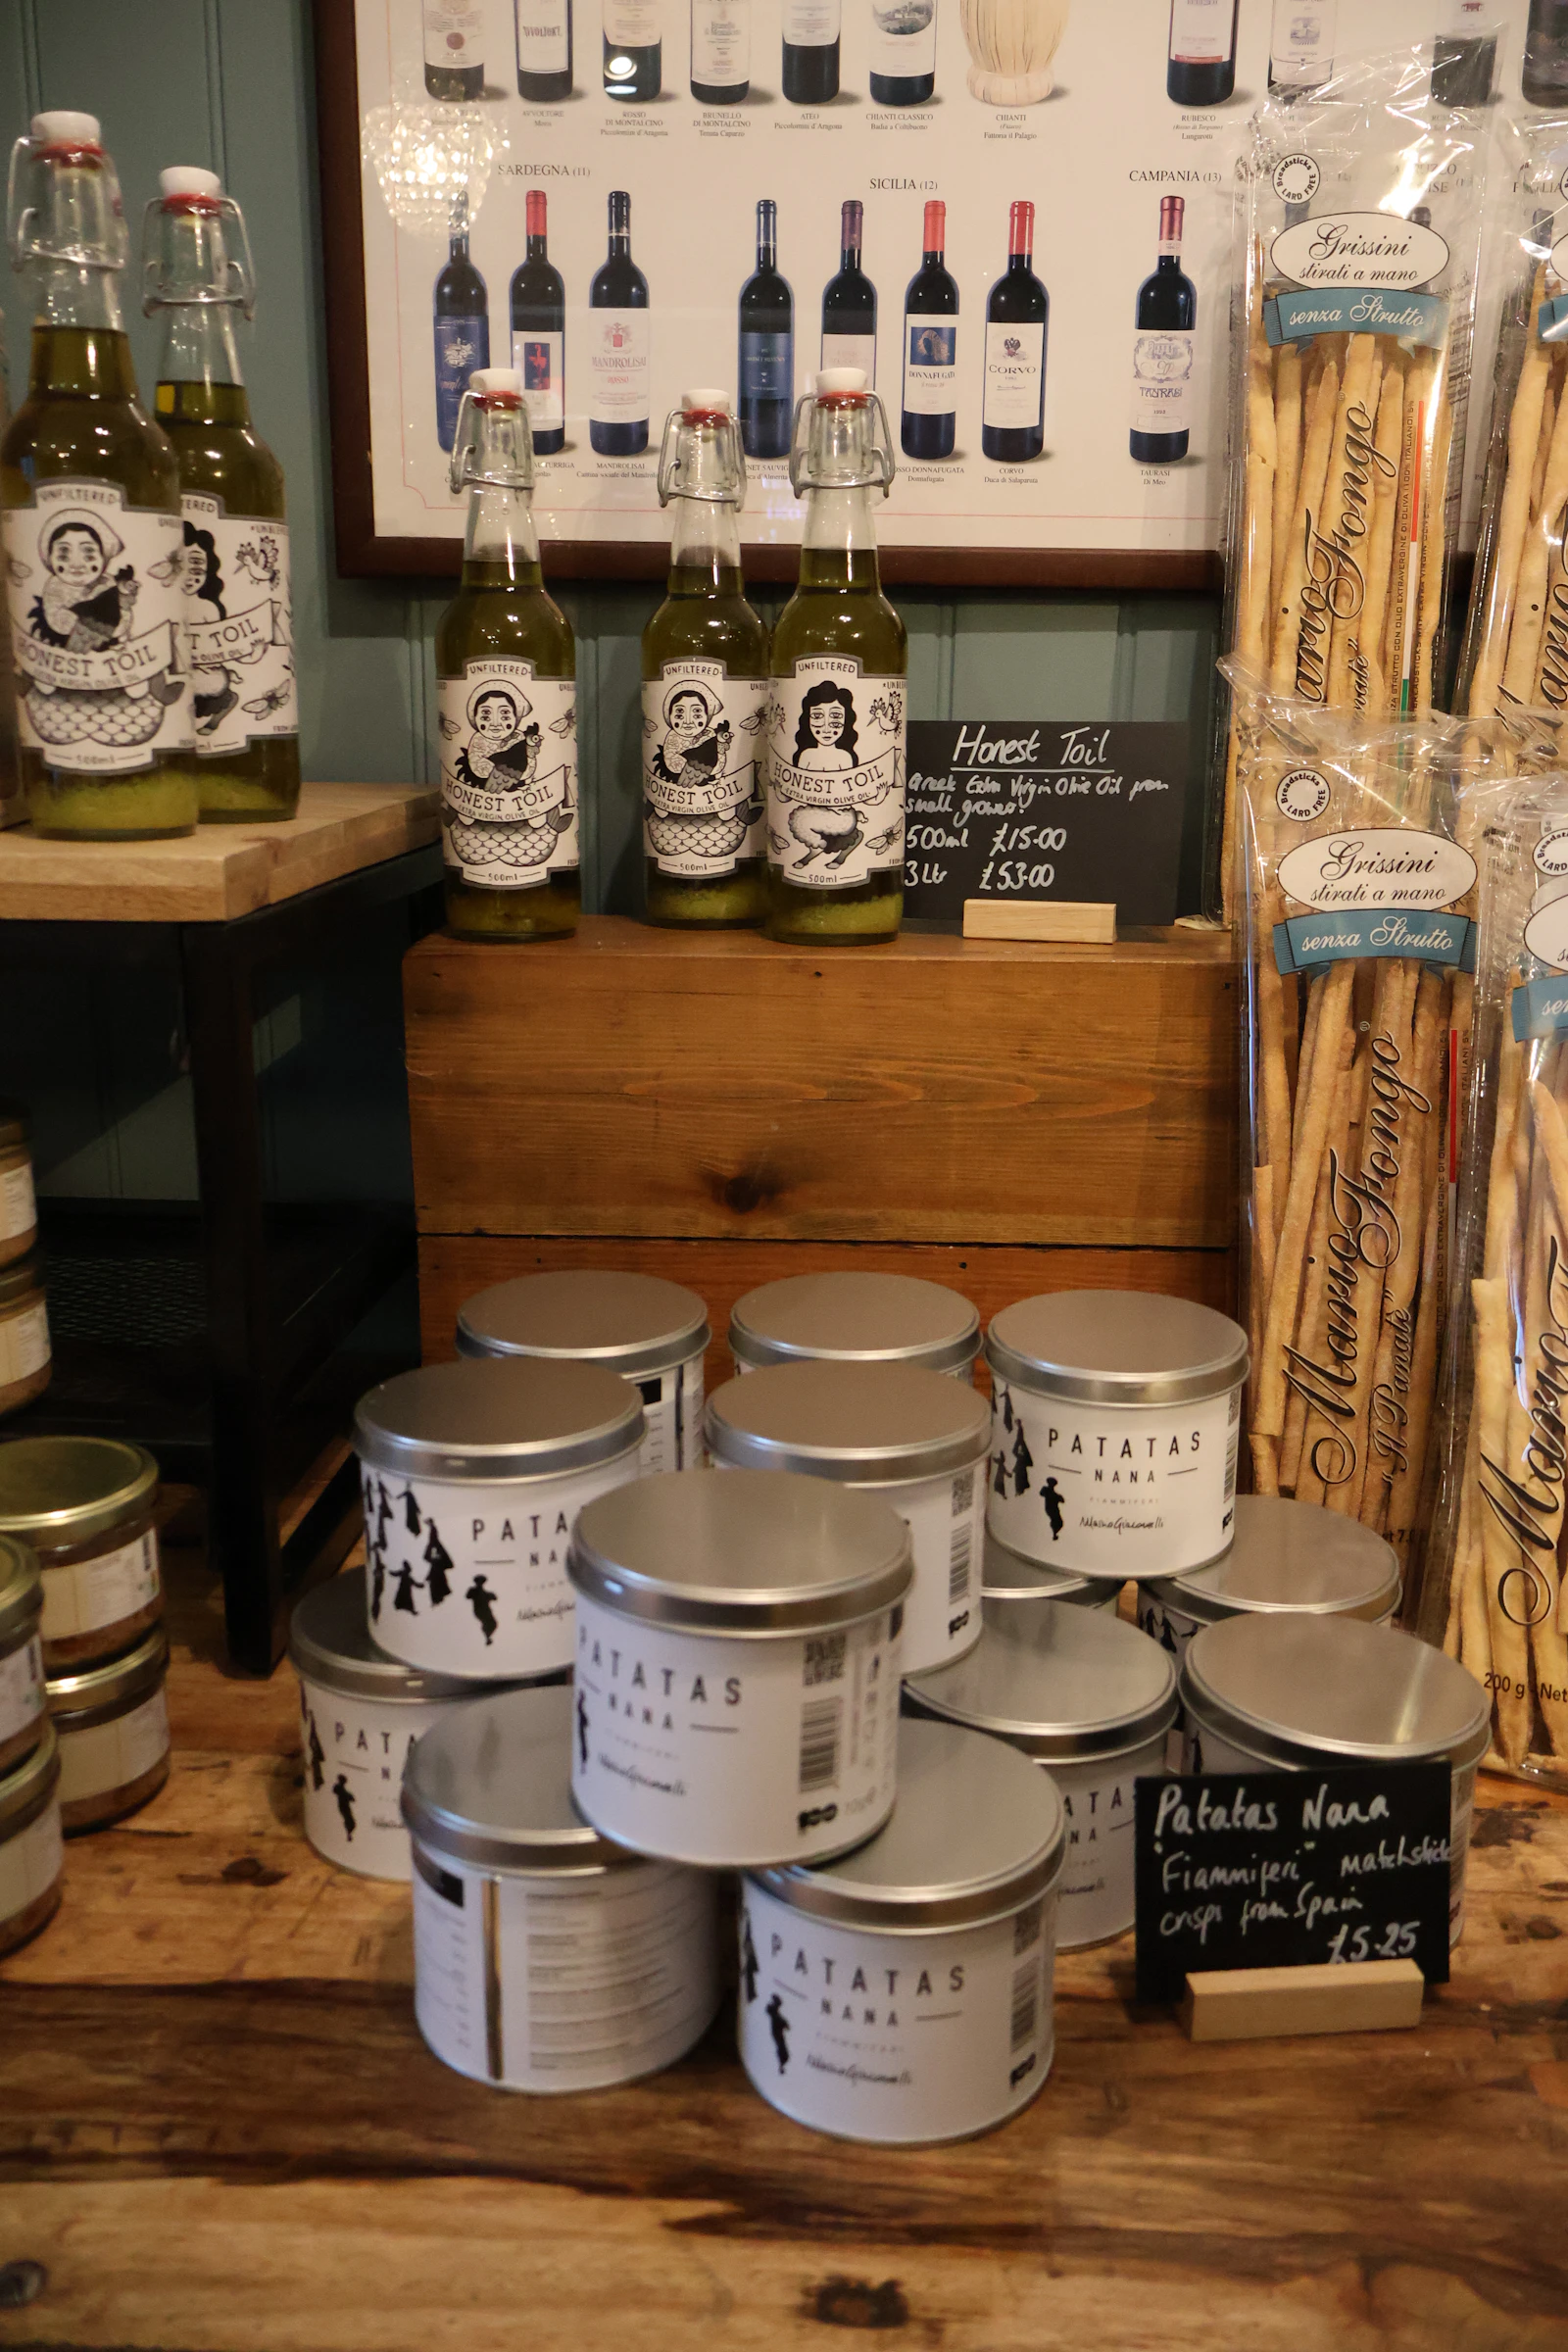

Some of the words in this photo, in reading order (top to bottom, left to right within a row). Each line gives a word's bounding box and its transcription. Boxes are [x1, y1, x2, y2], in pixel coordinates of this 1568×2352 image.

[1014, 131, 1037, 140] Palagio
[498, 164, 570, 176] SARDEGNA
[869, 177, 917, 190] SICILIA
[919, 180, 938, 191] (12)
[1129, 170, 1200, 182] CAMPANIA
[1202, 172, 1222, 183] (13)
[1276, 157, 1312, 187] Breadsticks
[1281, 187, 1302, 200] LARD
[1303, 172, 1317, 195] FREE
[1308, 222, 1413, 261] Grissini
[1298, 263, 1351, 280] stirati
[1353, 270, 1366, 280] a
[1370, 270, 1419, 281] mano
[1289, 307, 1343, 326] senza
[1349, 294, 1425, 326] Strutto
[592, 356, 647, 368] MANDROLISAI
[988, 364, 1037, 374] CORVO
[41, 489, 119, 507] UNFILTERED
[1305, 400, 1397, 619] Fongo
[1400, 521, 1408, 532] DI
[1396, 535, 1407, 604] EXTRAVERGINE
[209, 618, 259, 648] TOIL
[103, 644, 157, 676] TOIL
[469, 662, 529, 676] UNFILTERED
[665, 664, 720, 677] UNFILTERED
[798, 662, 856, 674] UNFILTERED
[1391, 654, 1400, 694] STRUTTO
[952, 724, 1041, 765] Honest
[1059, 726, 1110, 765] Toil
[645, 774, 696, 806] HONEST
[703, 780, 743, 805] TOIL
[773, 761, 835, 794] HONEST
[843, 764, 884, 792] TOIL
[908, 772, 956, 792] Greek
[1010, 774, 1052, 808] Virgin
[1054, 776, 1092, 796] Olive
[1096, 776, 1123, 796] Oil
[1129, 780, 1169, 802] from
[1281, 772, 1320, 804] Breadsticks
[446, 778, 506, 811] HONEST
[512, 785, 554, 811] TOIL
[671, 805, 695, 814] VIRGIN
[696, 804, 716, 813] OLIVE
[718, 801, 730, 809] OIL
[785, 787, 804, 800] EXTRA
[806, 795, 831, 805] VIRGIN
[833, 795, 856, 805] OLIVE
[858, 792, 870, 801] OIL
[905, 793, 954, 813] small
[1287, 805, 1311, 817] LARD
[1312, 789, 1326, 811] FREE
[478, 811, 504, 821] VIRGIN
[505, 810, 526, 820] OLIVE
[529, 808, 540, 816] OIL
[906, 824, 969, 850] 500ml
[989, 822, 1068, 858] £15.00
[679, 861, 708, 871] 500ml
[979, 860, 1055, 891] £53.00
[1320, 840, 1439, 881] Grissini
[1542, 858, 1568, 872] LARD
[488, 871, 518, 882] 500ml
[808, 873, 838, 883] 500ml
[1310, 883, 1369, 902] stirati
[1372, 890, 1385, 901] a
[1391, 890, 1446, 901] mano
[1301, 932, 1361, 952] senza
[1369, 915, 1454, 951] Strutto
[1282, 1229, 1359, 1485] Mario
[1329, 1029, 1432, 1268] Fongo
[1048, 1428, 1200, 1458] PATATAS
[1094, 1469, 1155, 1484] NANA
[472, 1510, 569, 1542] PATA
[529, 1552, 558, 1567] NA
[1483, 1671, 1511, 1693] 200
[1515, 1682, 1526, 1699] g
[1540, 1682, 1568, 1704] Net
[608, 1691, 673, 1731] NANA
[1153, 1783, 1278, 1838] Patatas
[1240, 1898, 1289, 1936] from
[1293, 1881, 1363, 1930] Spain
[1326, 1920, 1421, 1964] £5.25
[771, 1932, 964, 1995] PATATAS
[820, 1997, 899, 2027] NANA
